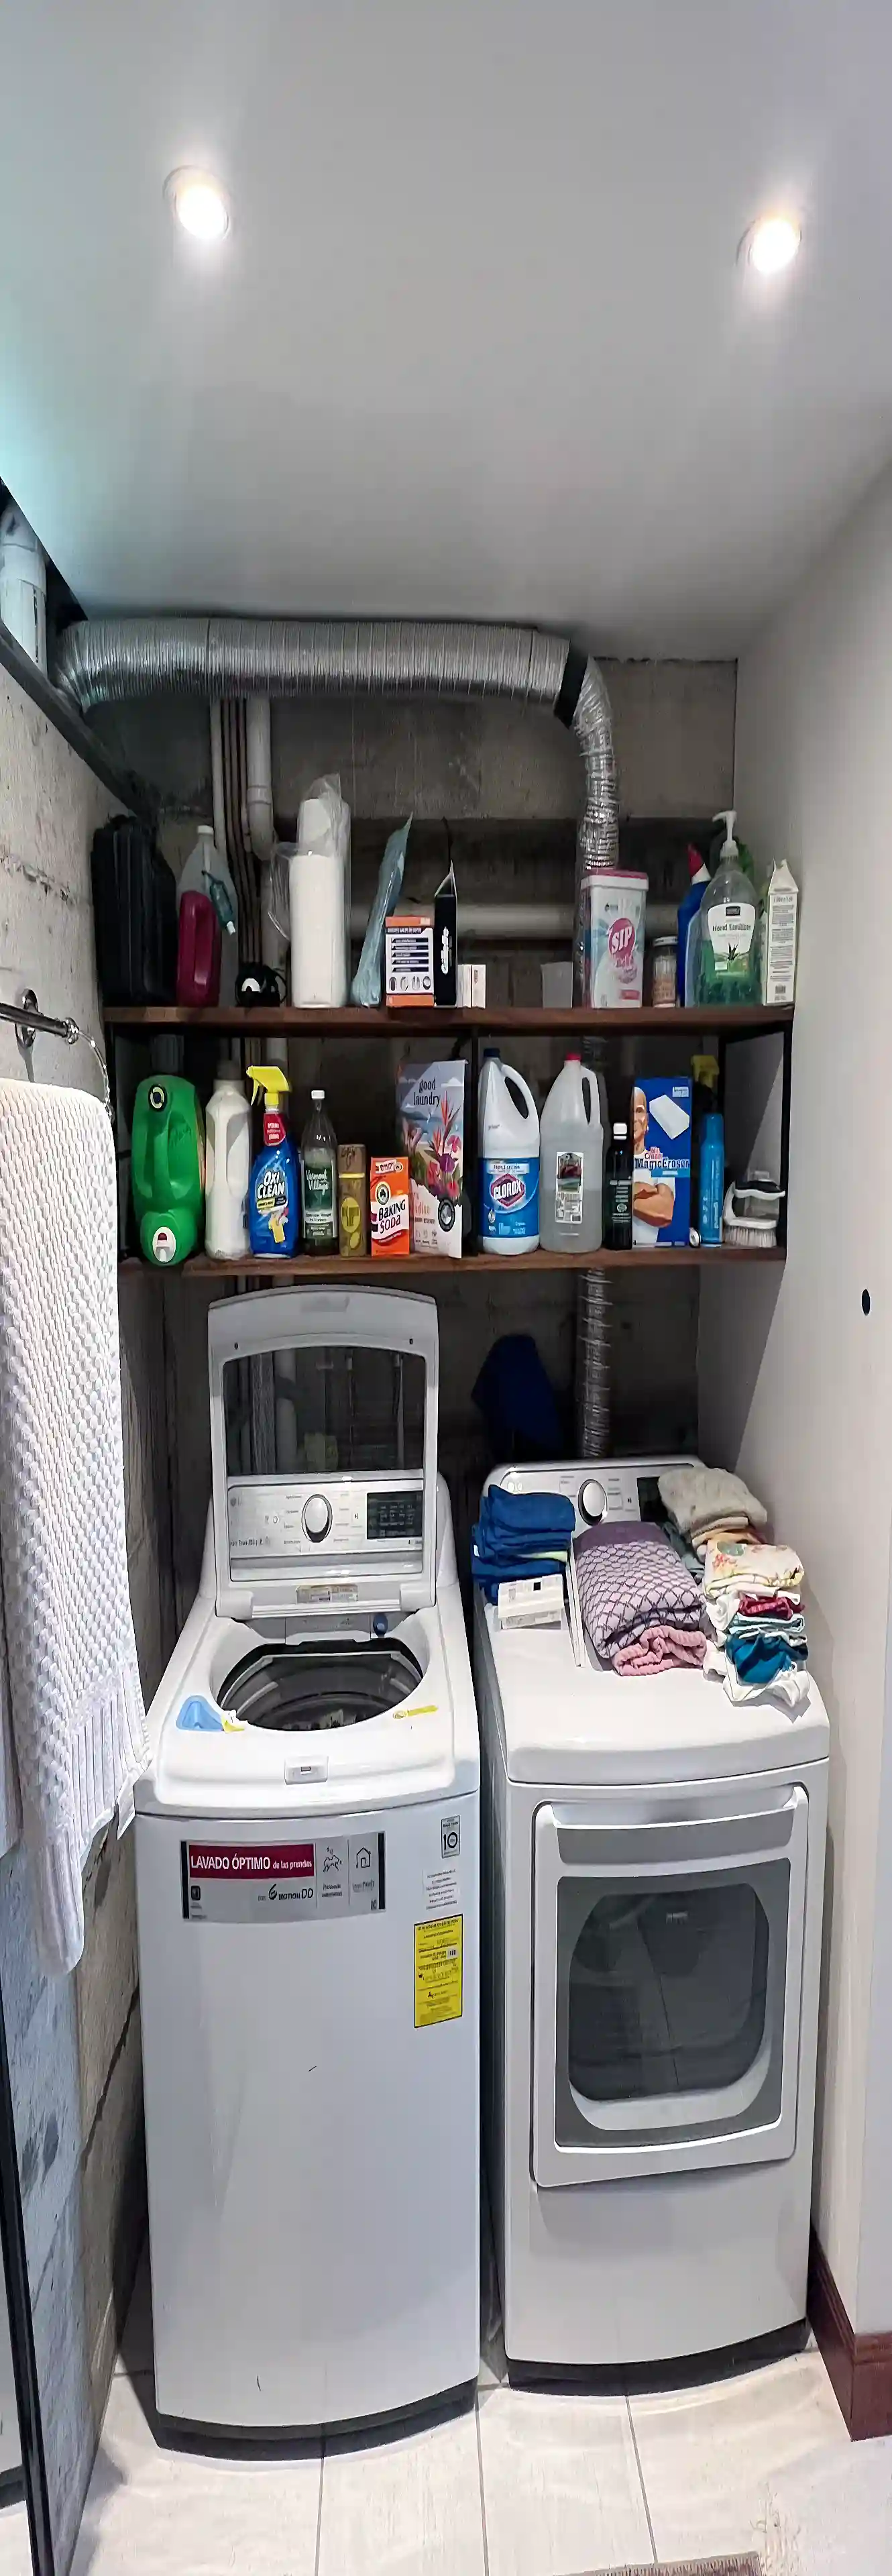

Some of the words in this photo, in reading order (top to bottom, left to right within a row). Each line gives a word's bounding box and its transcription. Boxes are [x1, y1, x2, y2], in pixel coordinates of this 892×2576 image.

[612, 926, 632, 954] SIP
[419, 1077, 436, 1093] good
[413, 1091, 441, 1108] laundry
[263, 1171, 280, 1186] OXI
[257, 1182, 286, 1199] CLEAN
[493, 1179, 522, 1201] CLOROX
[443, 1831, 458, 1850] 10
[190, 1855, 230, 1870] LAVADO
[231, 1854, 271, 1870] ÓPTIMO
[272, 1861, 280, 1869] de
[280, 1860, 288, 1869] las
[290, 1859, 313, 1870] prendas
